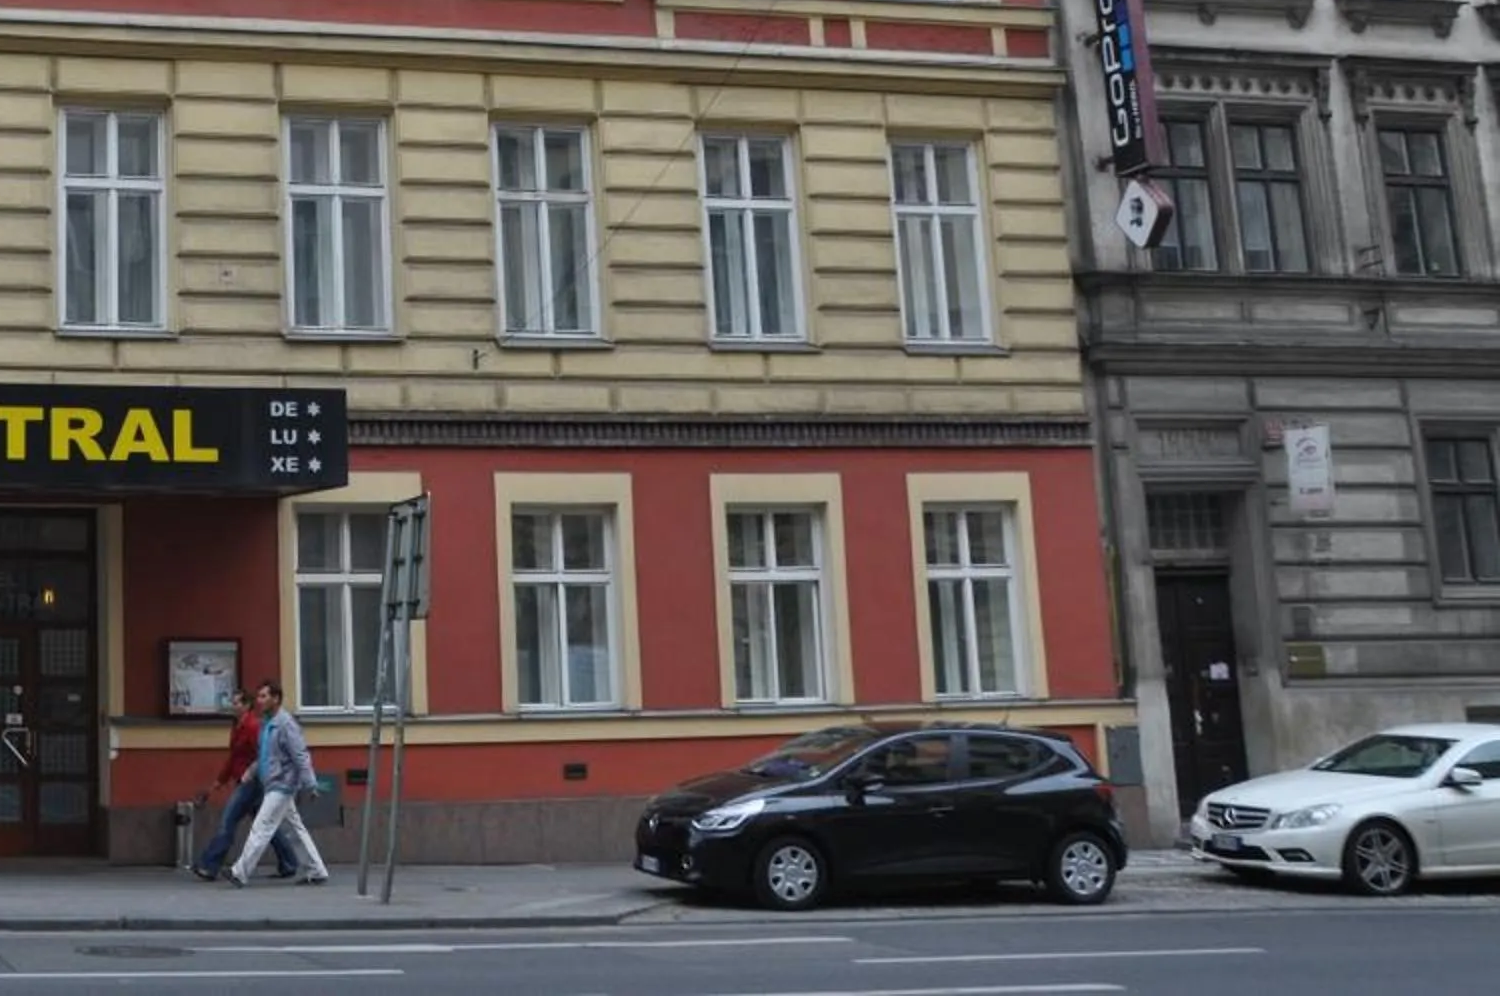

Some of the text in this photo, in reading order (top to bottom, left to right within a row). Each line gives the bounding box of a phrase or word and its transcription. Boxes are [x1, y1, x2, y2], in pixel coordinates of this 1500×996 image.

[270, 401, 298, 418] DE
[270, 429, 298, 445] LU
[270, 456, 299, 473] XE
